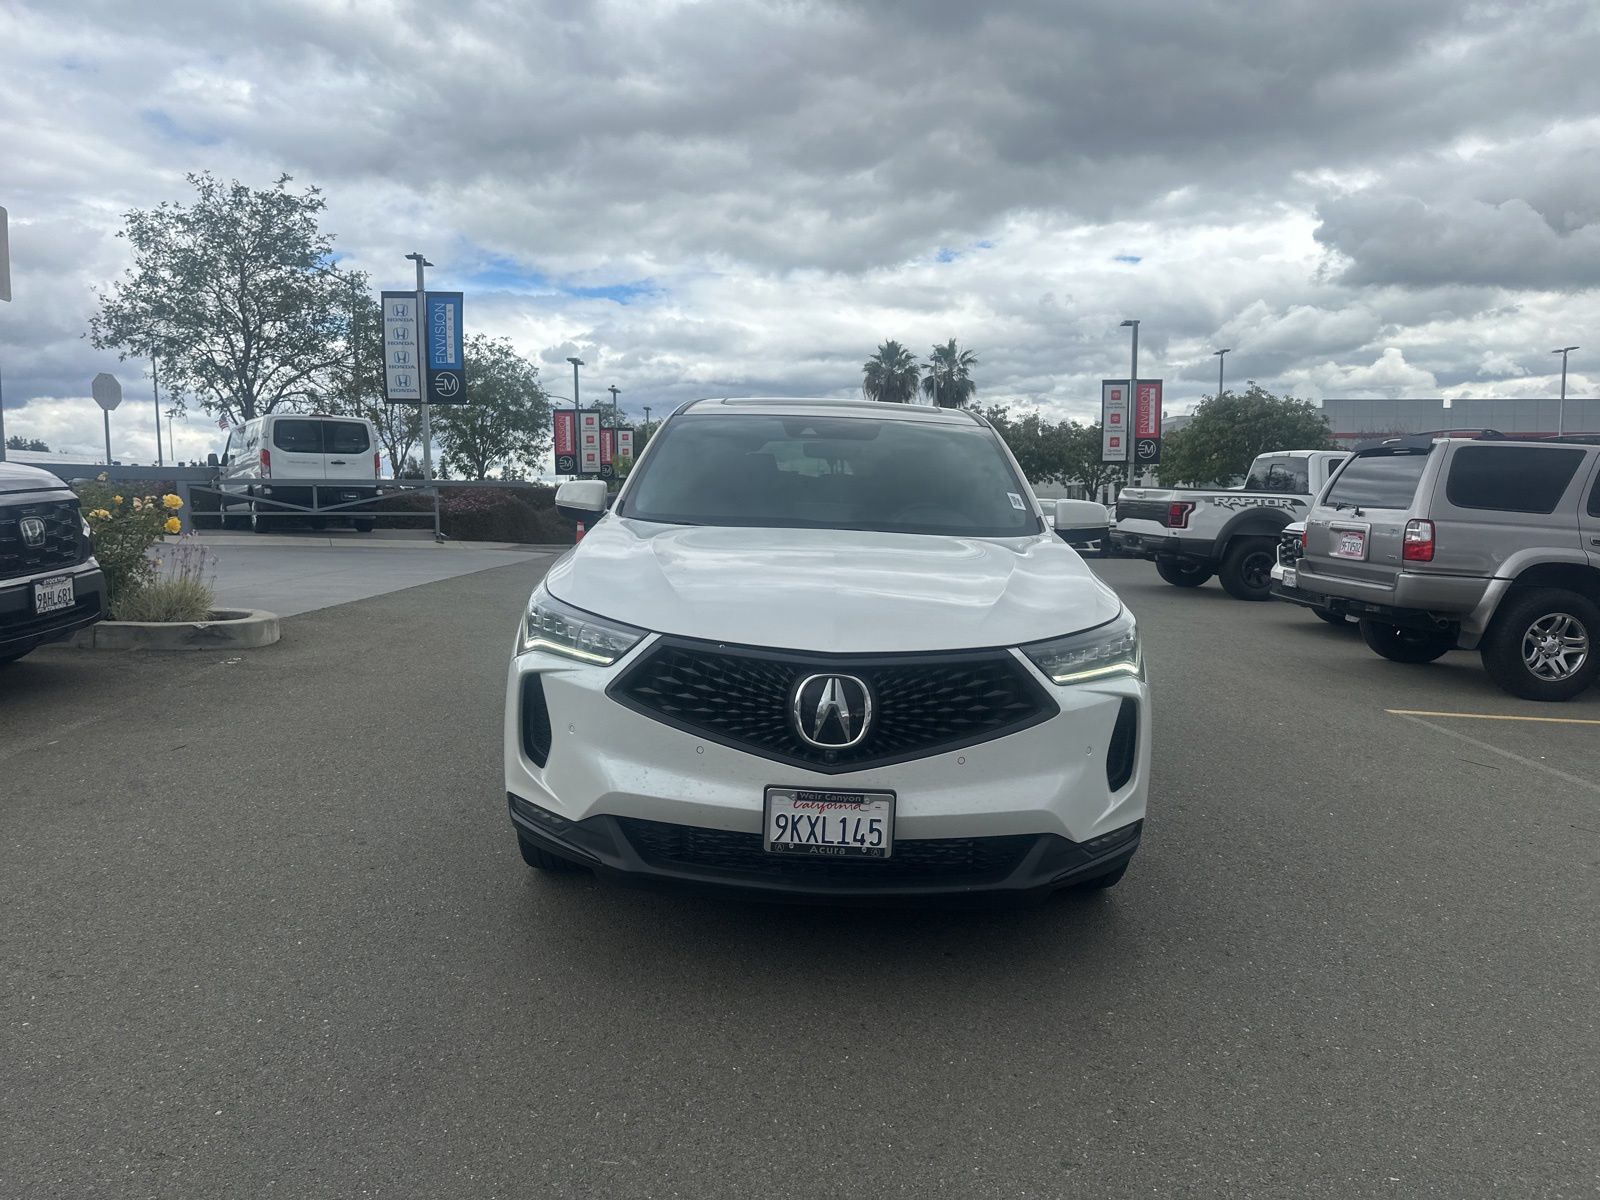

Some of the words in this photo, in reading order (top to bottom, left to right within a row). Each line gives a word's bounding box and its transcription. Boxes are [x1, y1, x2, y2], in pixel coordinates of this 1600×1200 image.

[435, 303, 446, 364] ENVISION
[1140, 387, 1150, 434] ENVISION
[1214, 497, 1297, 513] RAPTOR
[37, 586, 74, 610] 9AHL681
[793, 799, 862, 814] California
[800, 792, 822, 800] Weir
[825, 794, 861, 803] Canyon
[774, 813, 882, 846] 9KXL145
[809, 846, 846, 855] Acura
